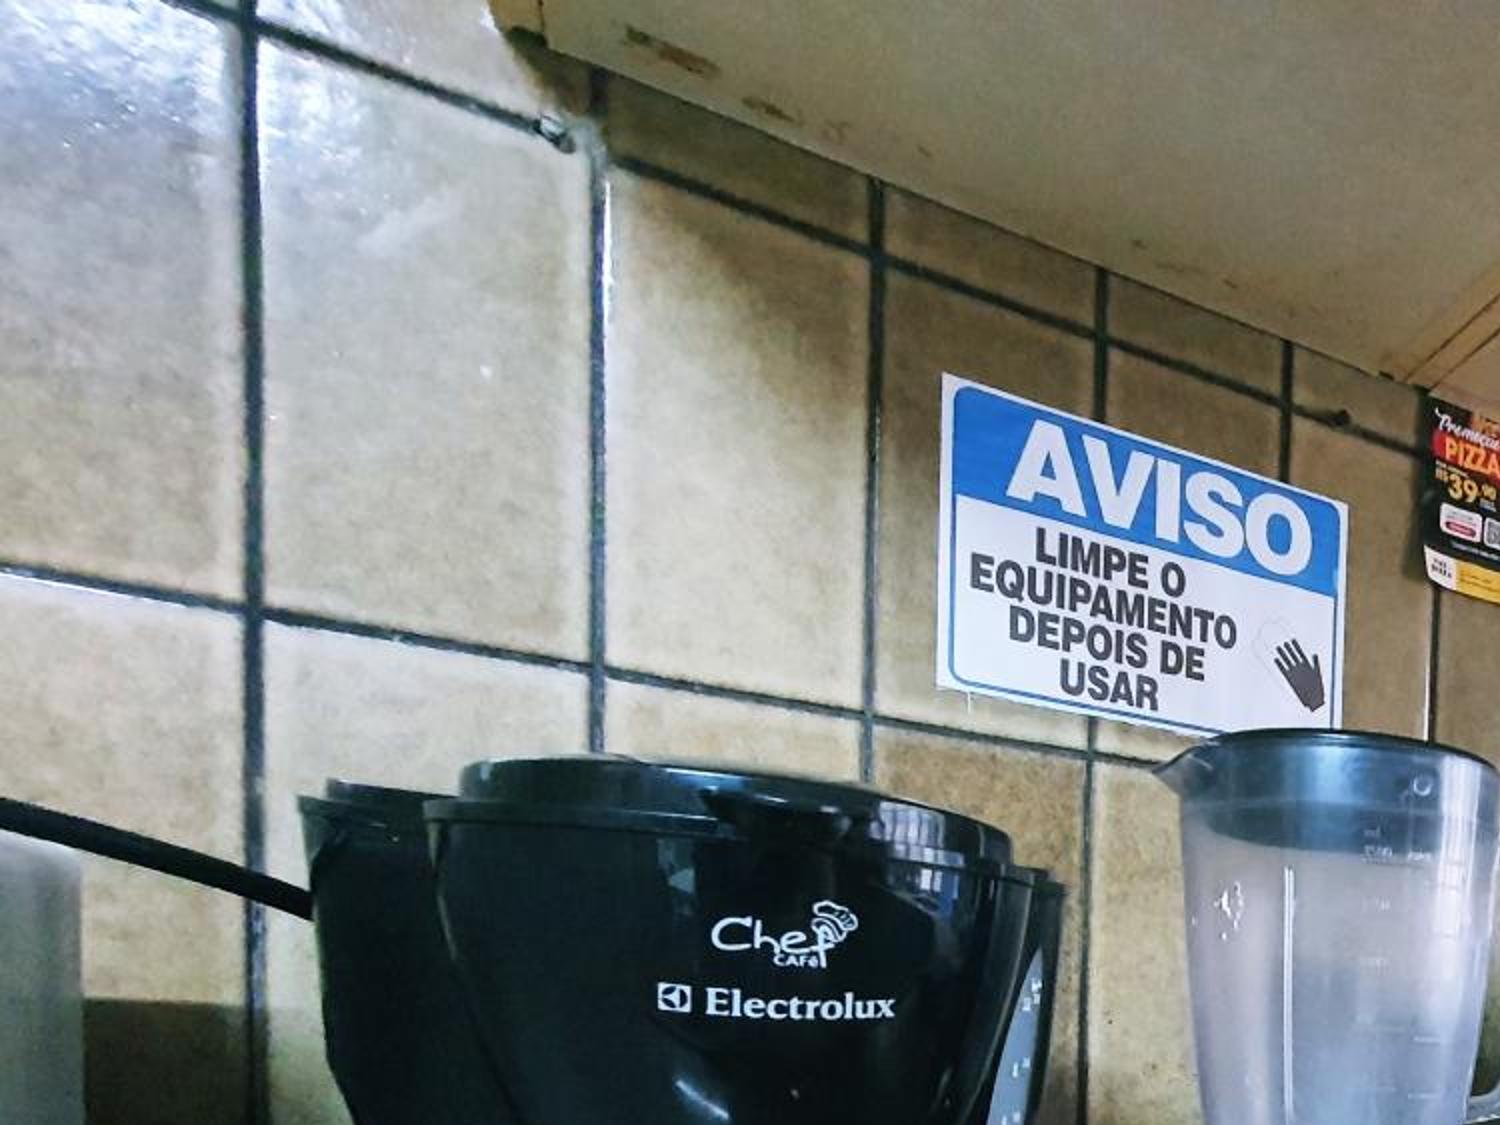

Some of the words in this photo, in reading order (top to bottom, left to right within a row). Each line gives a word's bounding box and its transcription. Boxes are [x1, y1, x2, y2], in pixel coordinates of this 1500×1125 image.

[1006, 419, 1312, 577] AVISO
[1036, 527, 1149, 590] LIMPE
[1160, 562, 1186, 597] O
[970, 552, 1238, 649] EQUIPAMENTO
[1009, 605, 1148, 669] DEPOIS
[1160, 644, 1205, 681] DE
[1060, 658, 1159, 711] USAR
[711, 908, 853, 968] Chef
[704, 986, 896, 1020] Electrolux
